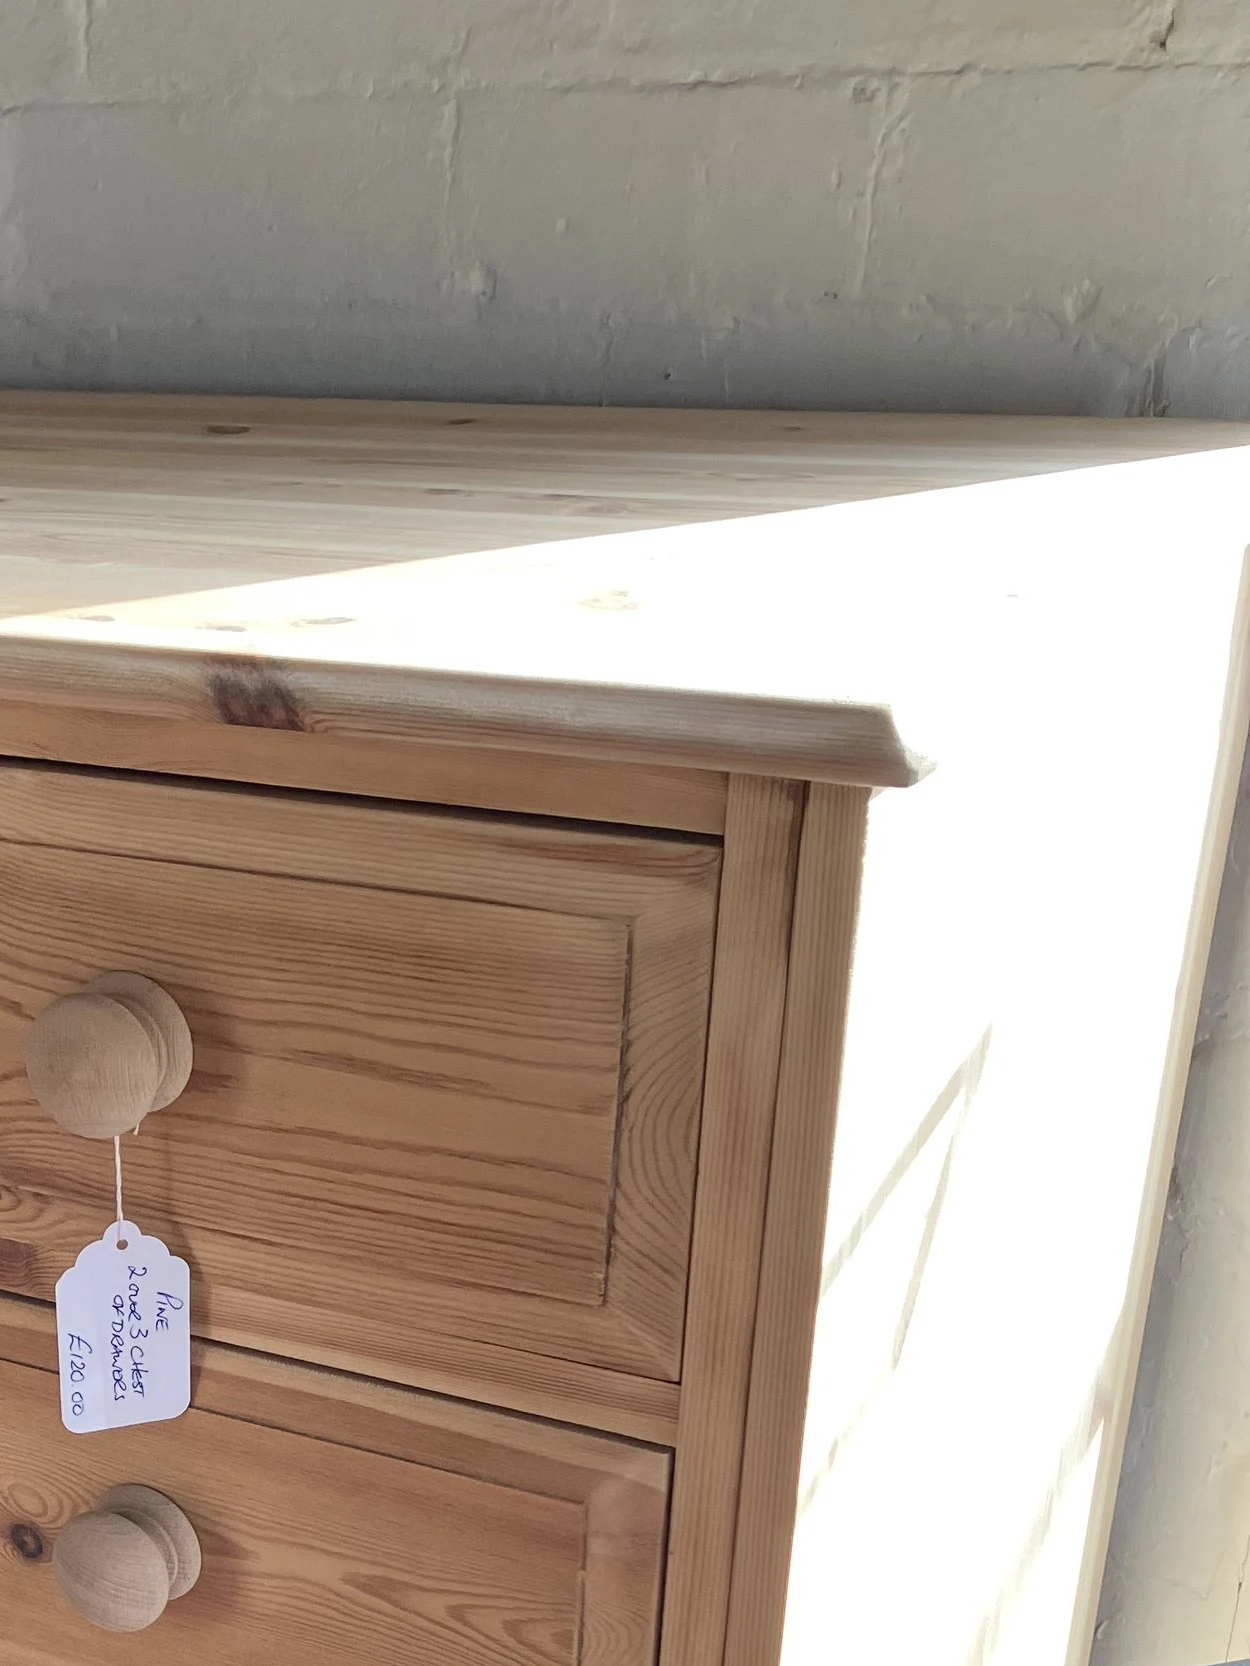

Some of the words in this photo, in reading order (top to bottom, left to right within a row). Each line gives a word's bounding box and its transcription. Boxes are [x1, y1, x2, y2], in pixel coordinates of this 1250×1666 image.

[128, 1265, 147, 1281] 2
[155, 1291, 183, 1331] PINE
[129, 1326, 149, 1340] 3
[68, 1333, 93, 1416] £120.00
[130, 1346, 149, 1399] CHEST
